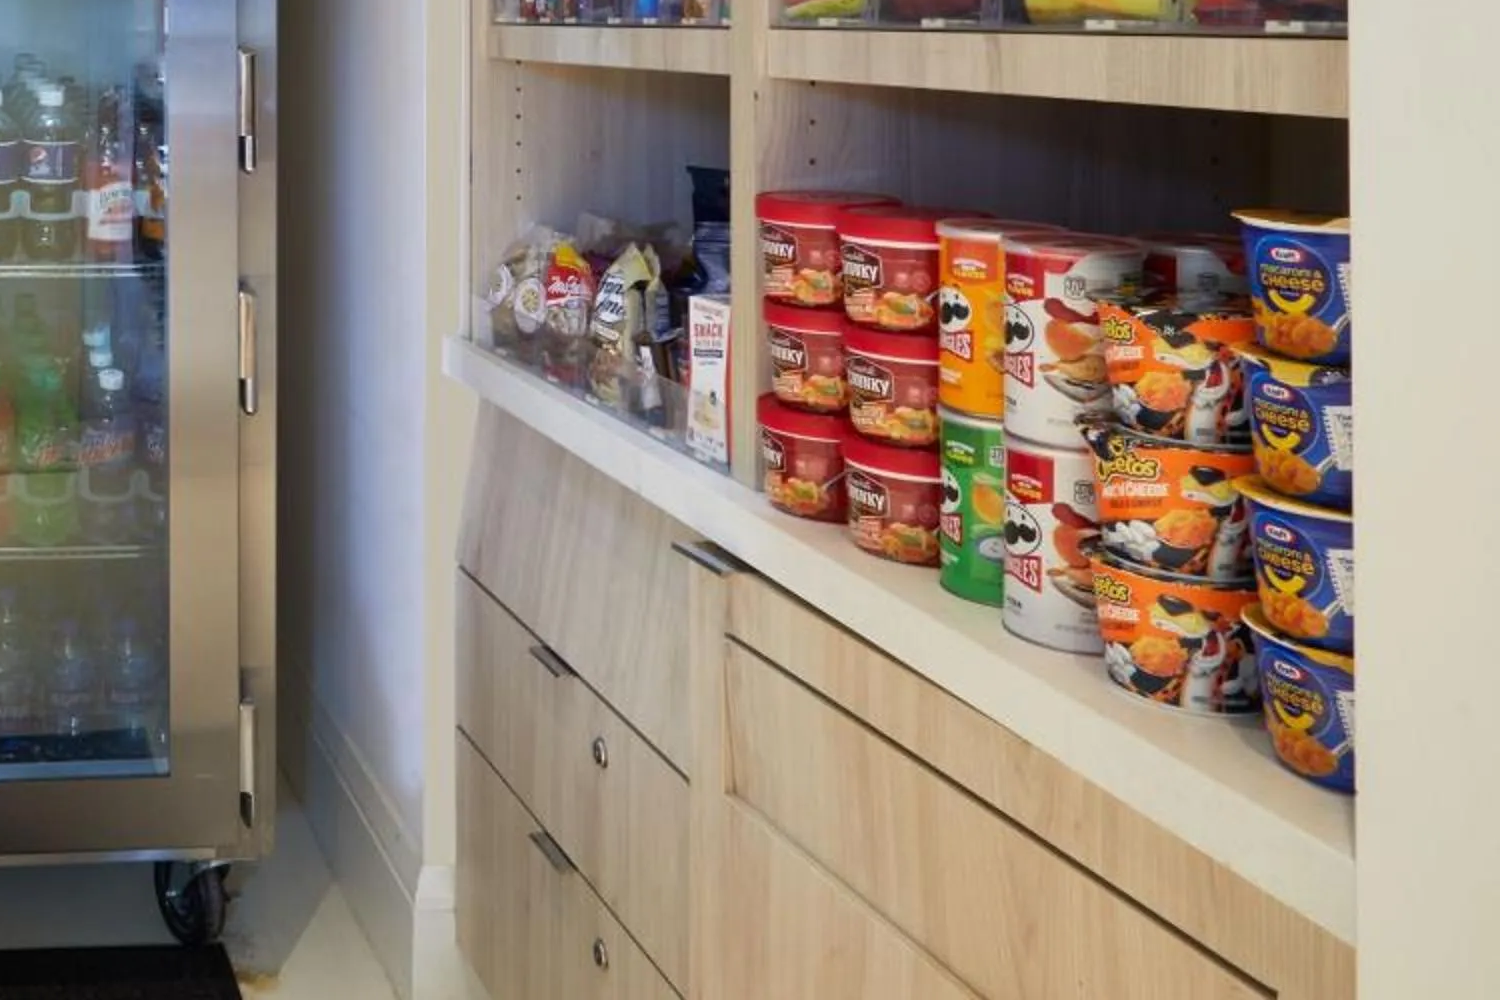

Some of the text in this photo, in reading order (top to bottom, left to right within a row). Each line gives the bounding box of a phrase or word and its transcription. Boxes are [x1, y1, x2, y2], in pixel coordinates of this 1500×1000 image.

[762, 240, 795, 260] HUNKY
[771, 346, 804, 366] HUNKY
[849, 370, 890, 397] HUNKY
[1096, 455, 1158, 481] eetos
